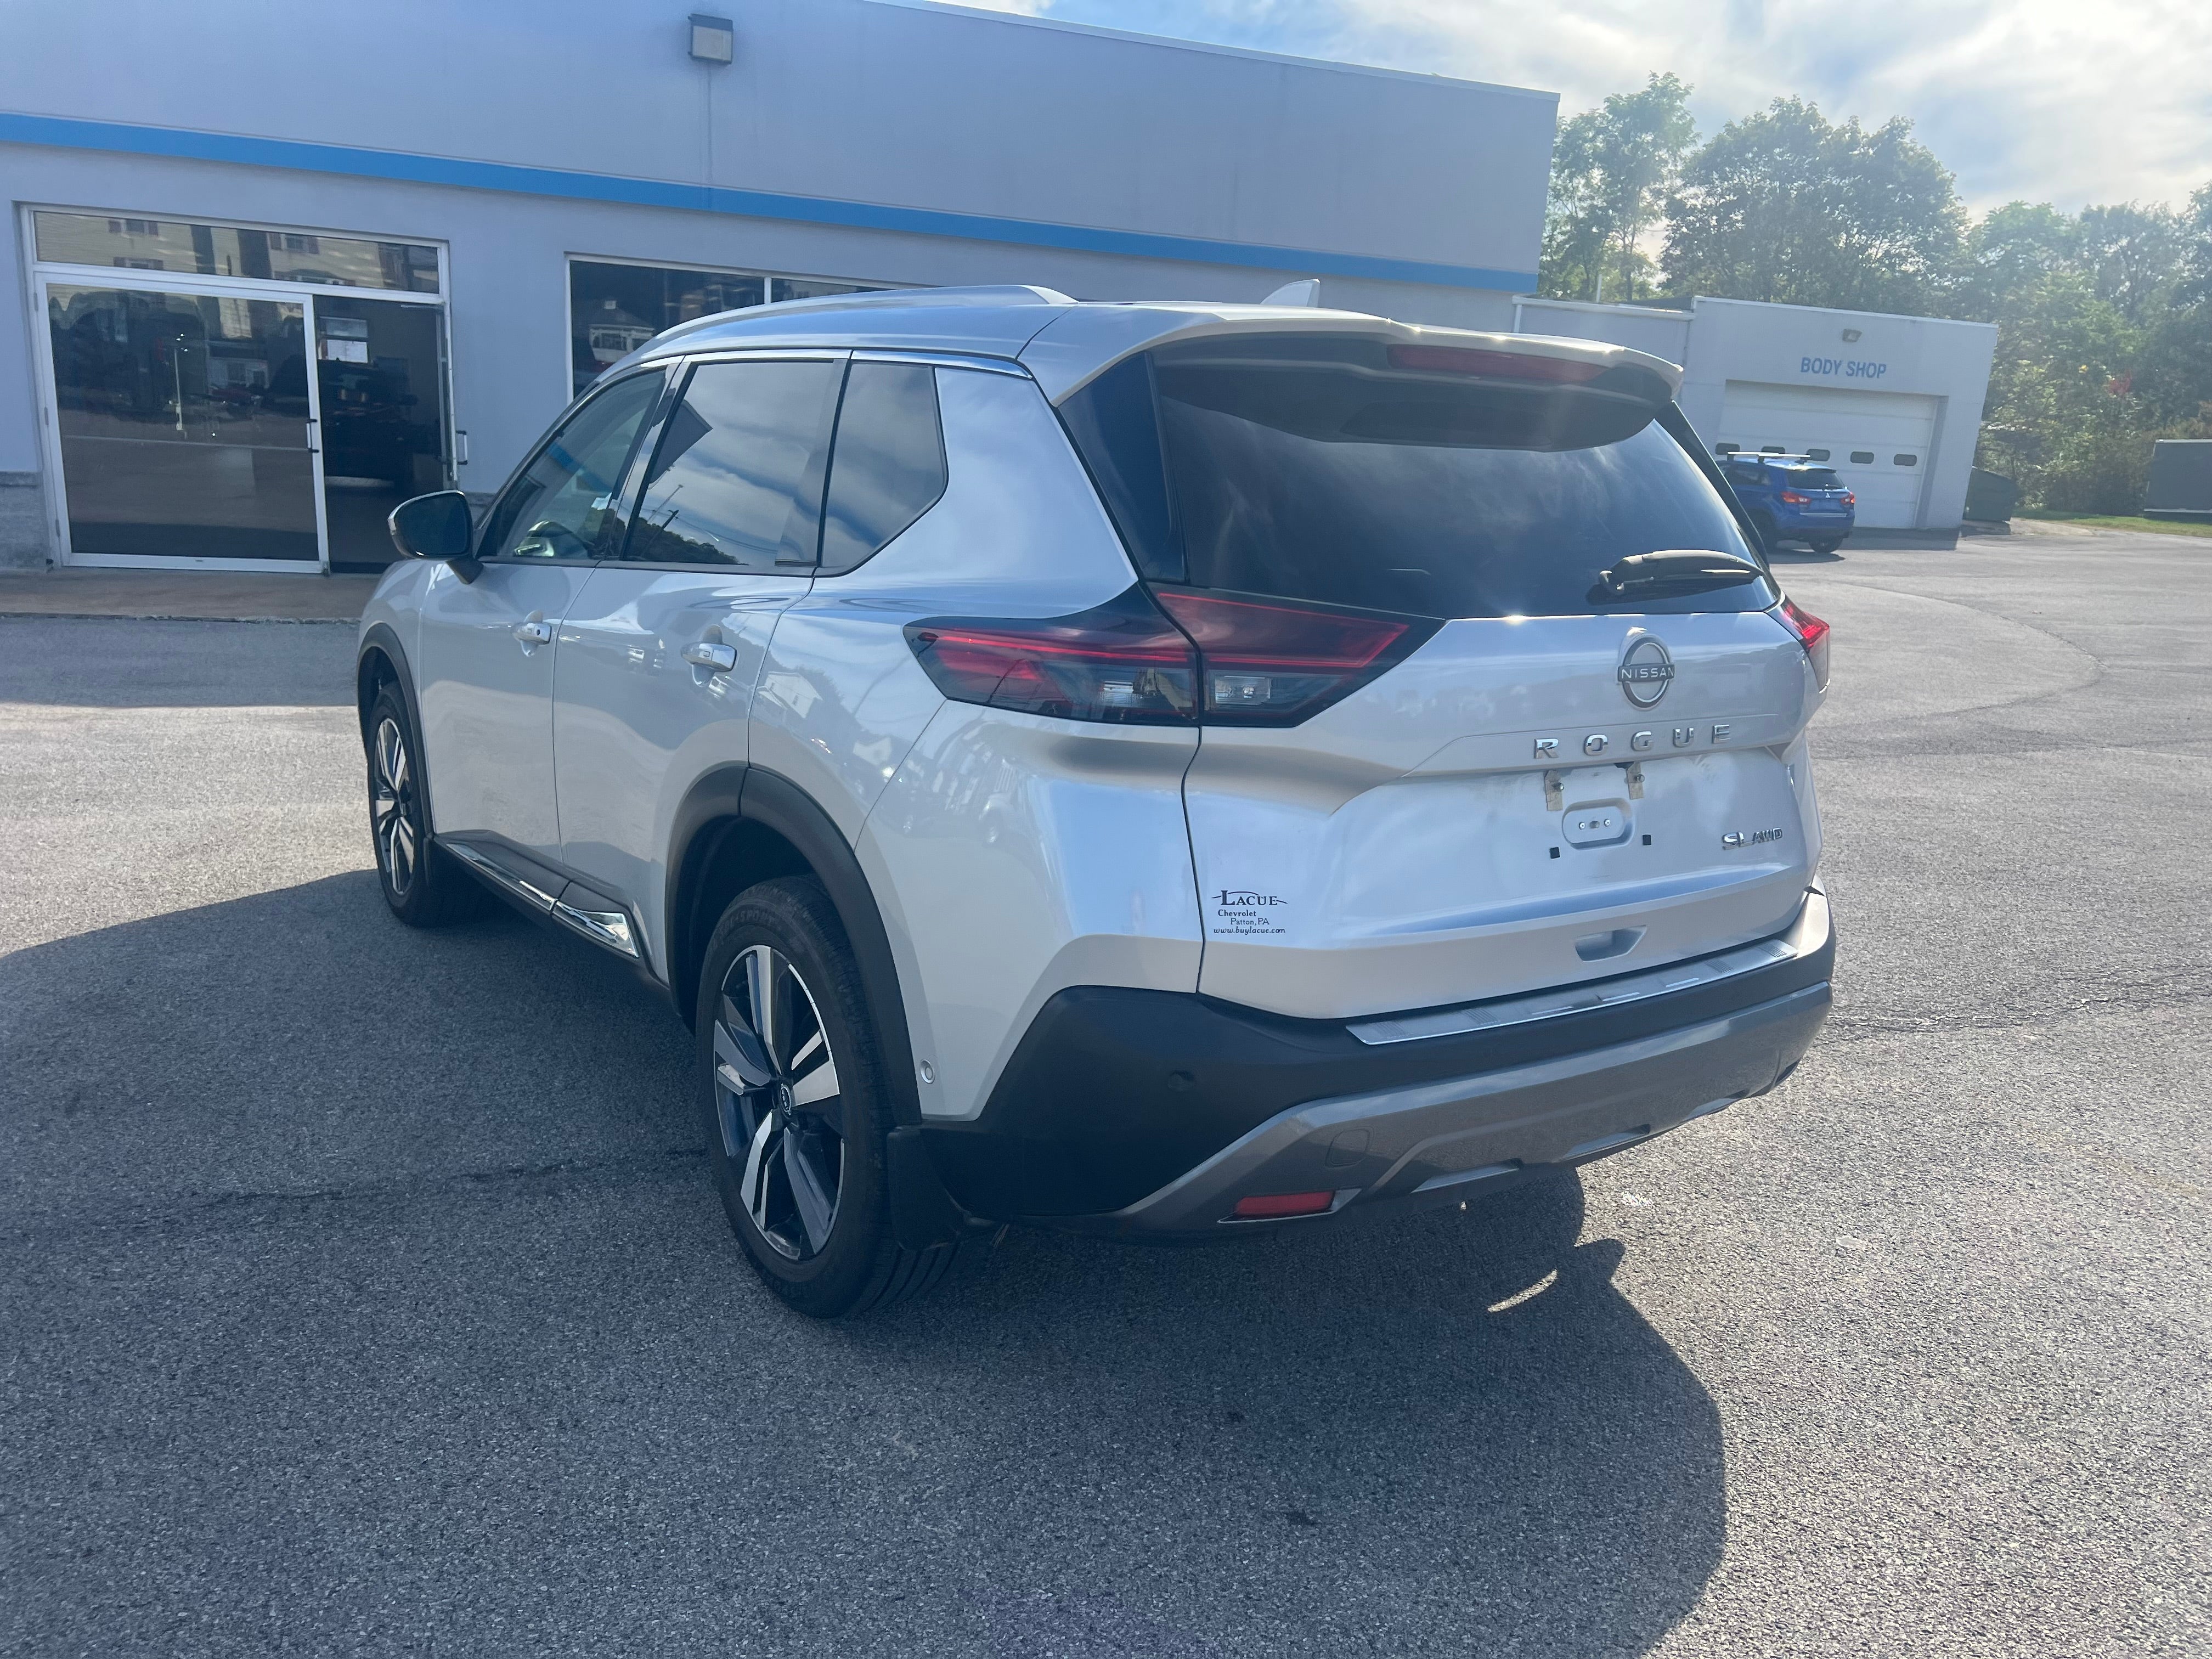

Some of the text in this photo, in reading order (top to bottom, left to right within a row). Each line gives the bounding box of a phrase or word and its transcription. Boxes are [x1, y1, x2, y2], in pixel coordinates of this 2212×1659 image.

[1800, 357, 1887, 379] BODY SHOP
[1621, 667, 1674, 680] NISSAN
[1534, 724, 1731, 759] ROGUE
[1722, 827, 1782, 850] SL AWD
[1221, 890, 1278, 906] LACUE
[1214, 926, 1286, 935] www.buylacue.com
